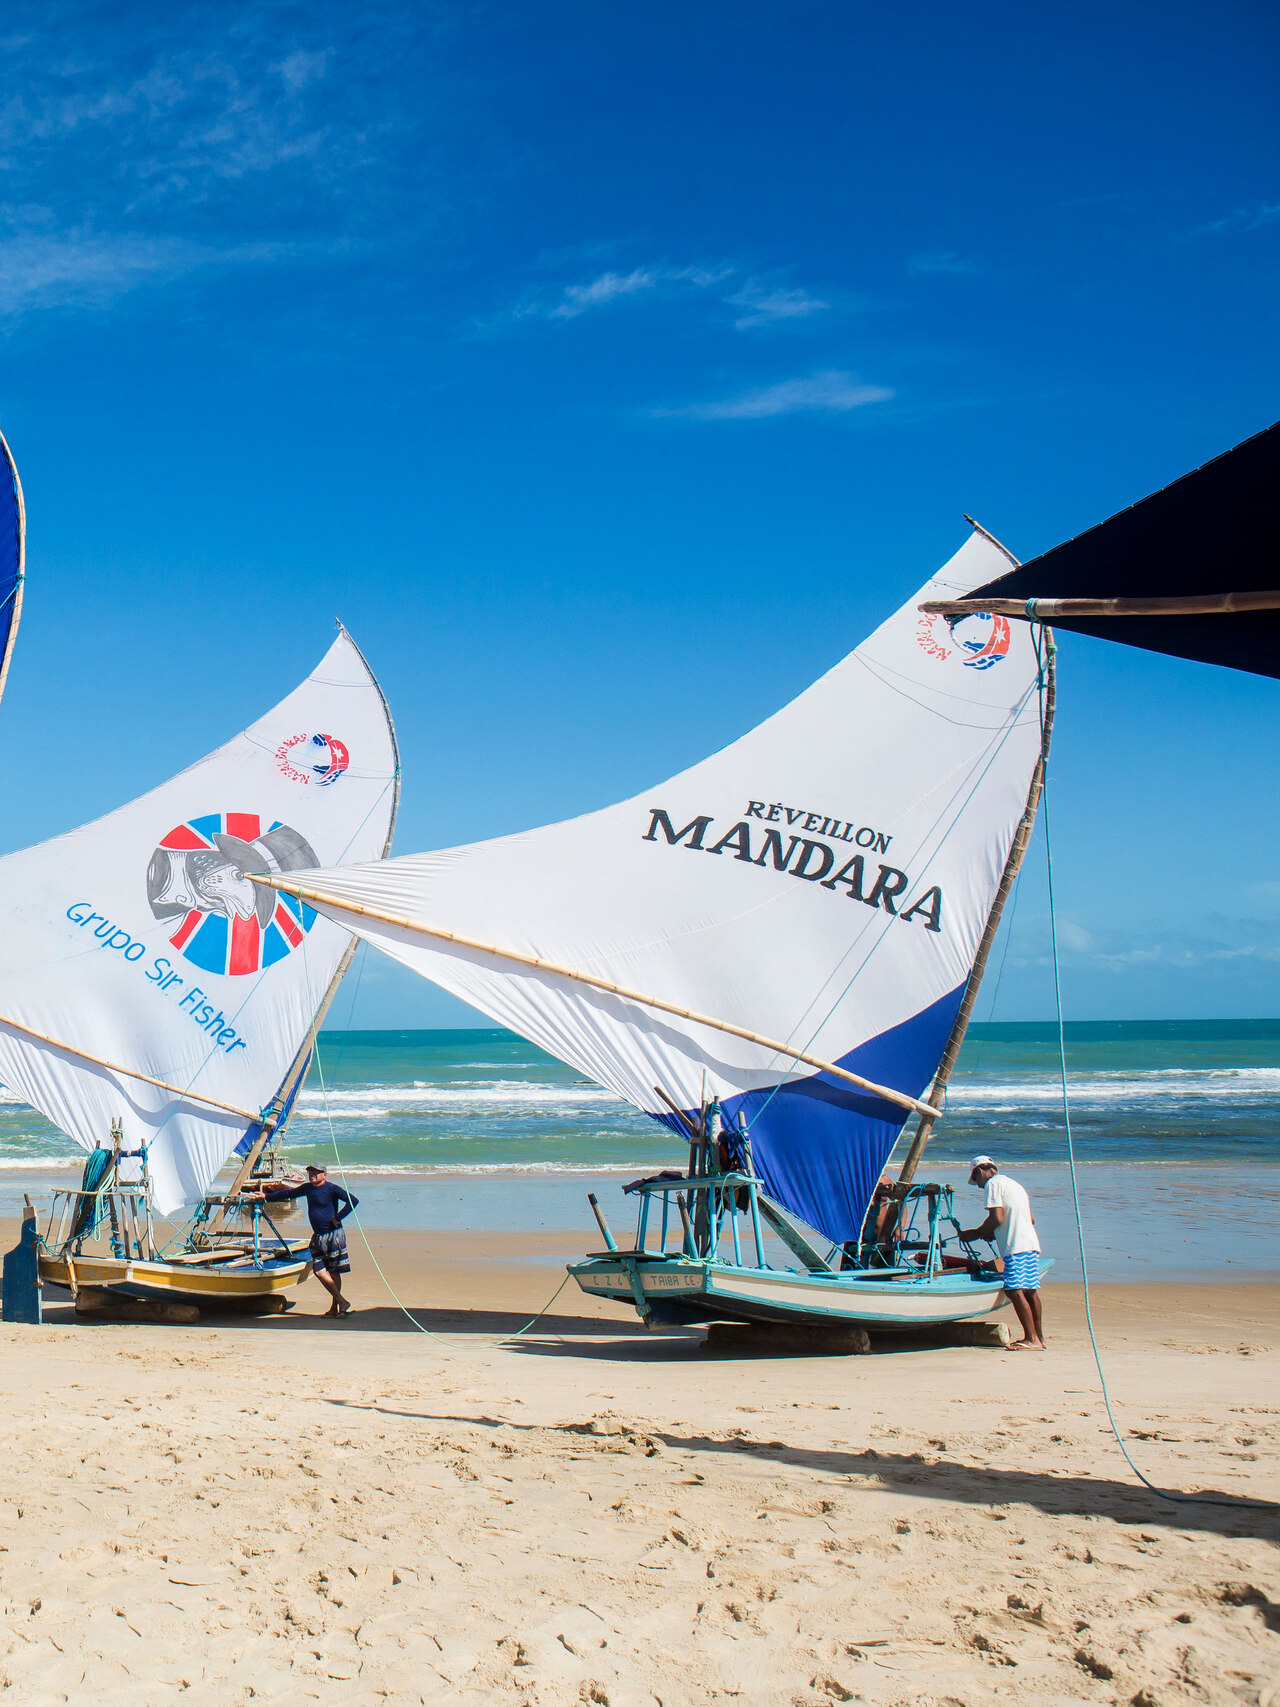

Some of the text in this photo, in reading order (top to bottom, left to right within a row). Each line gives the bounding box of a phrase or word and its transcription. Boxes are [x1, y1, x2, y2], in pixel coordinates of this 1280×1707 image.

[641, 808, 942, 933] MANDARA
[744, 800, 893, 855] RÉVEILLON
[66, 902, 146, 962] Grupo
[178, 986, 247, 1053] Fisher
